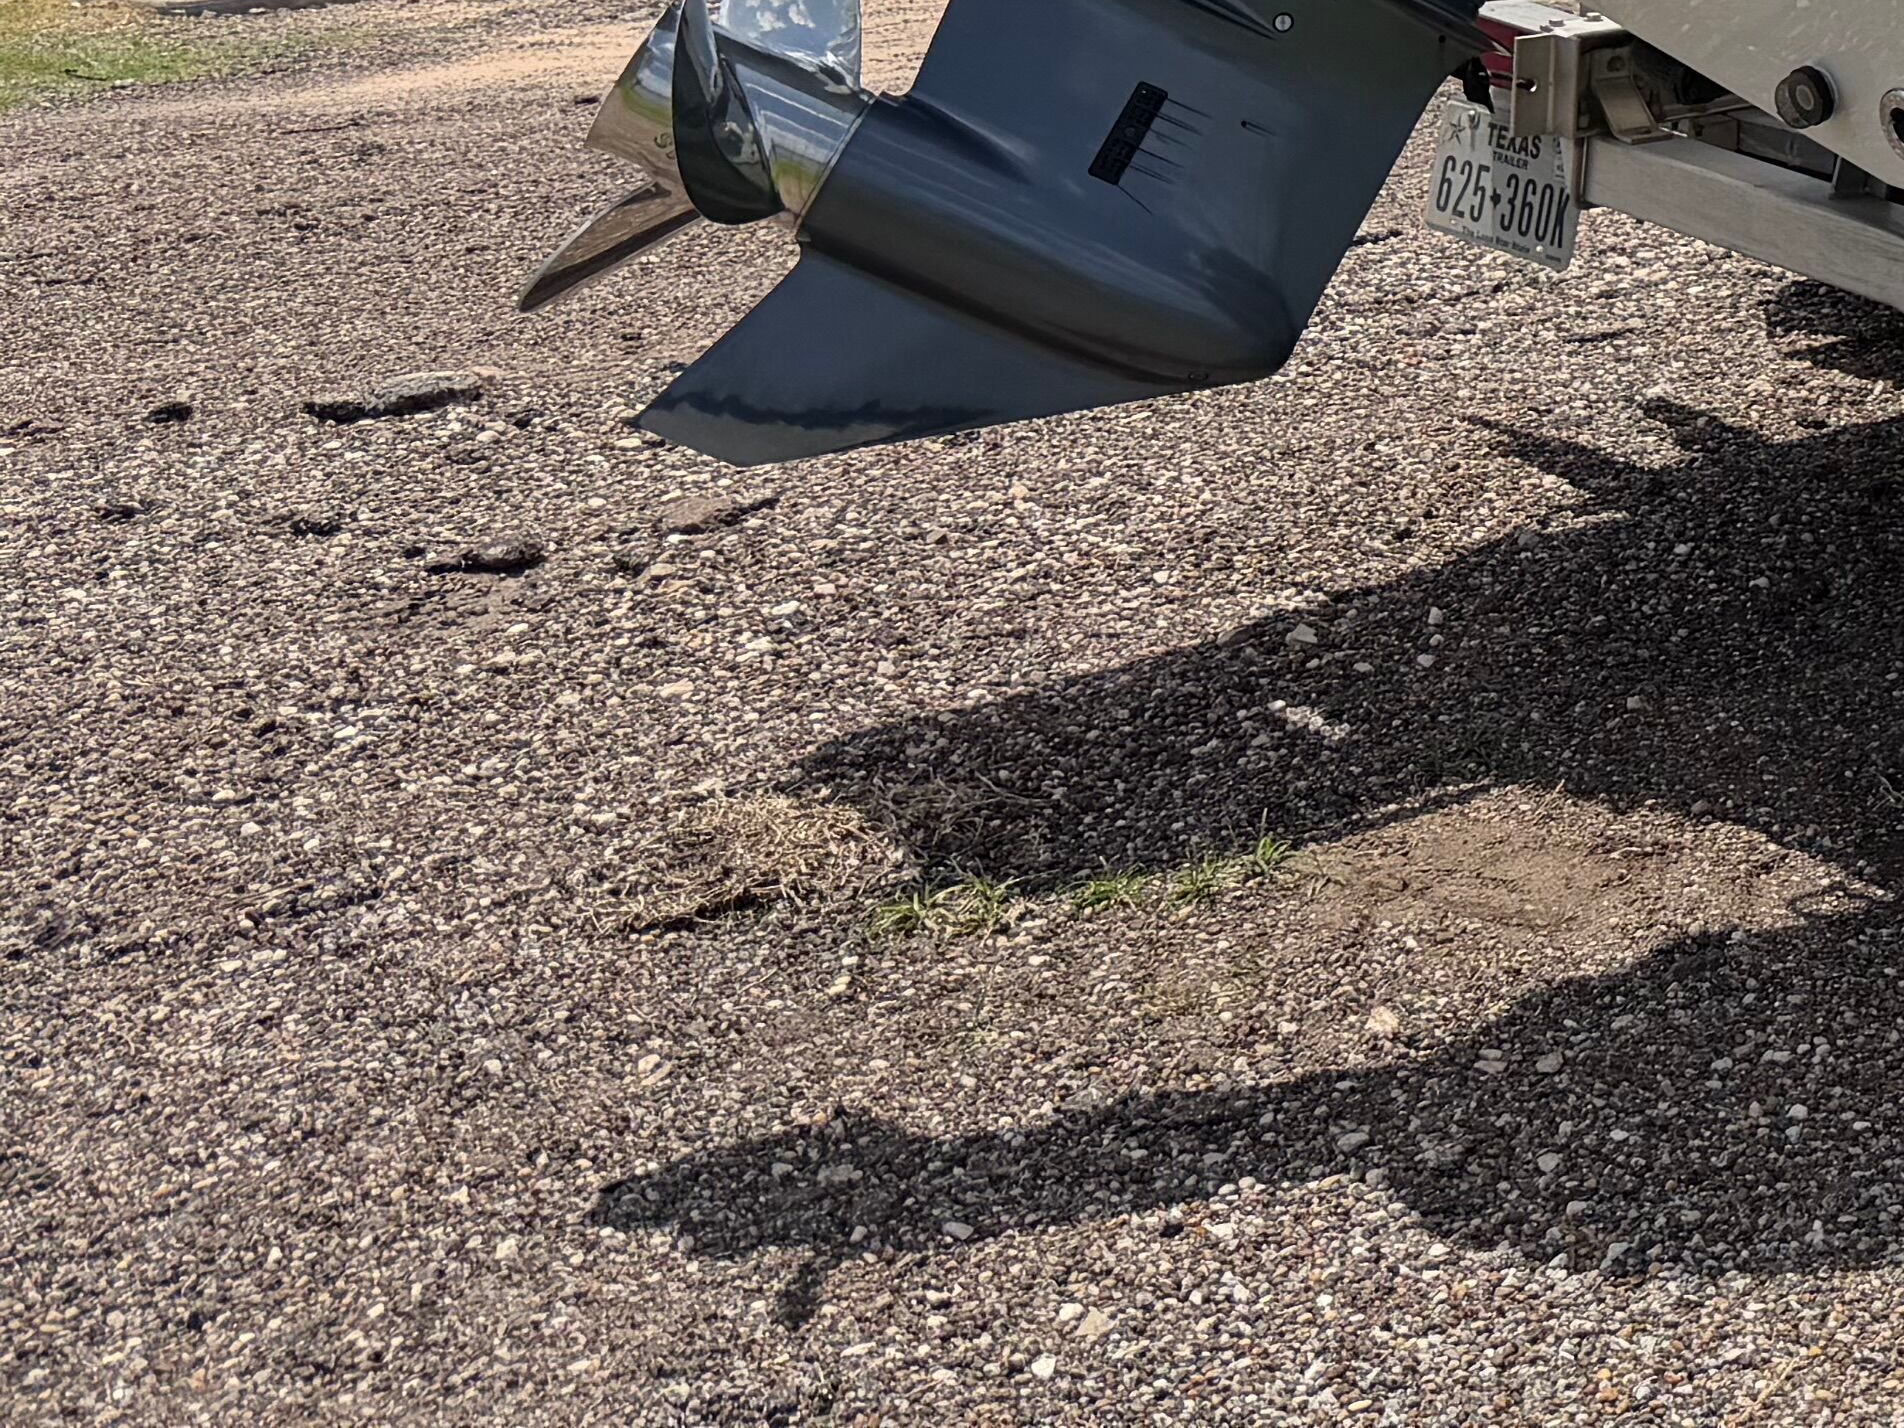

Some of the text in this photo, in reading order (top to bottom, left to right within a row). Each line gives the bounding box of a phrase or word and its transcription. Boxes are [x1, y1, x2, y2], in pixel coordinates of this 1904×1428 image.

[1487, 122, 1542, 159] TEXAS
[1493, 151, 1529, 170] TRAILER
[1436, 155, 1490, 223] 625
[1500, 173, 1570, 249] 360K
